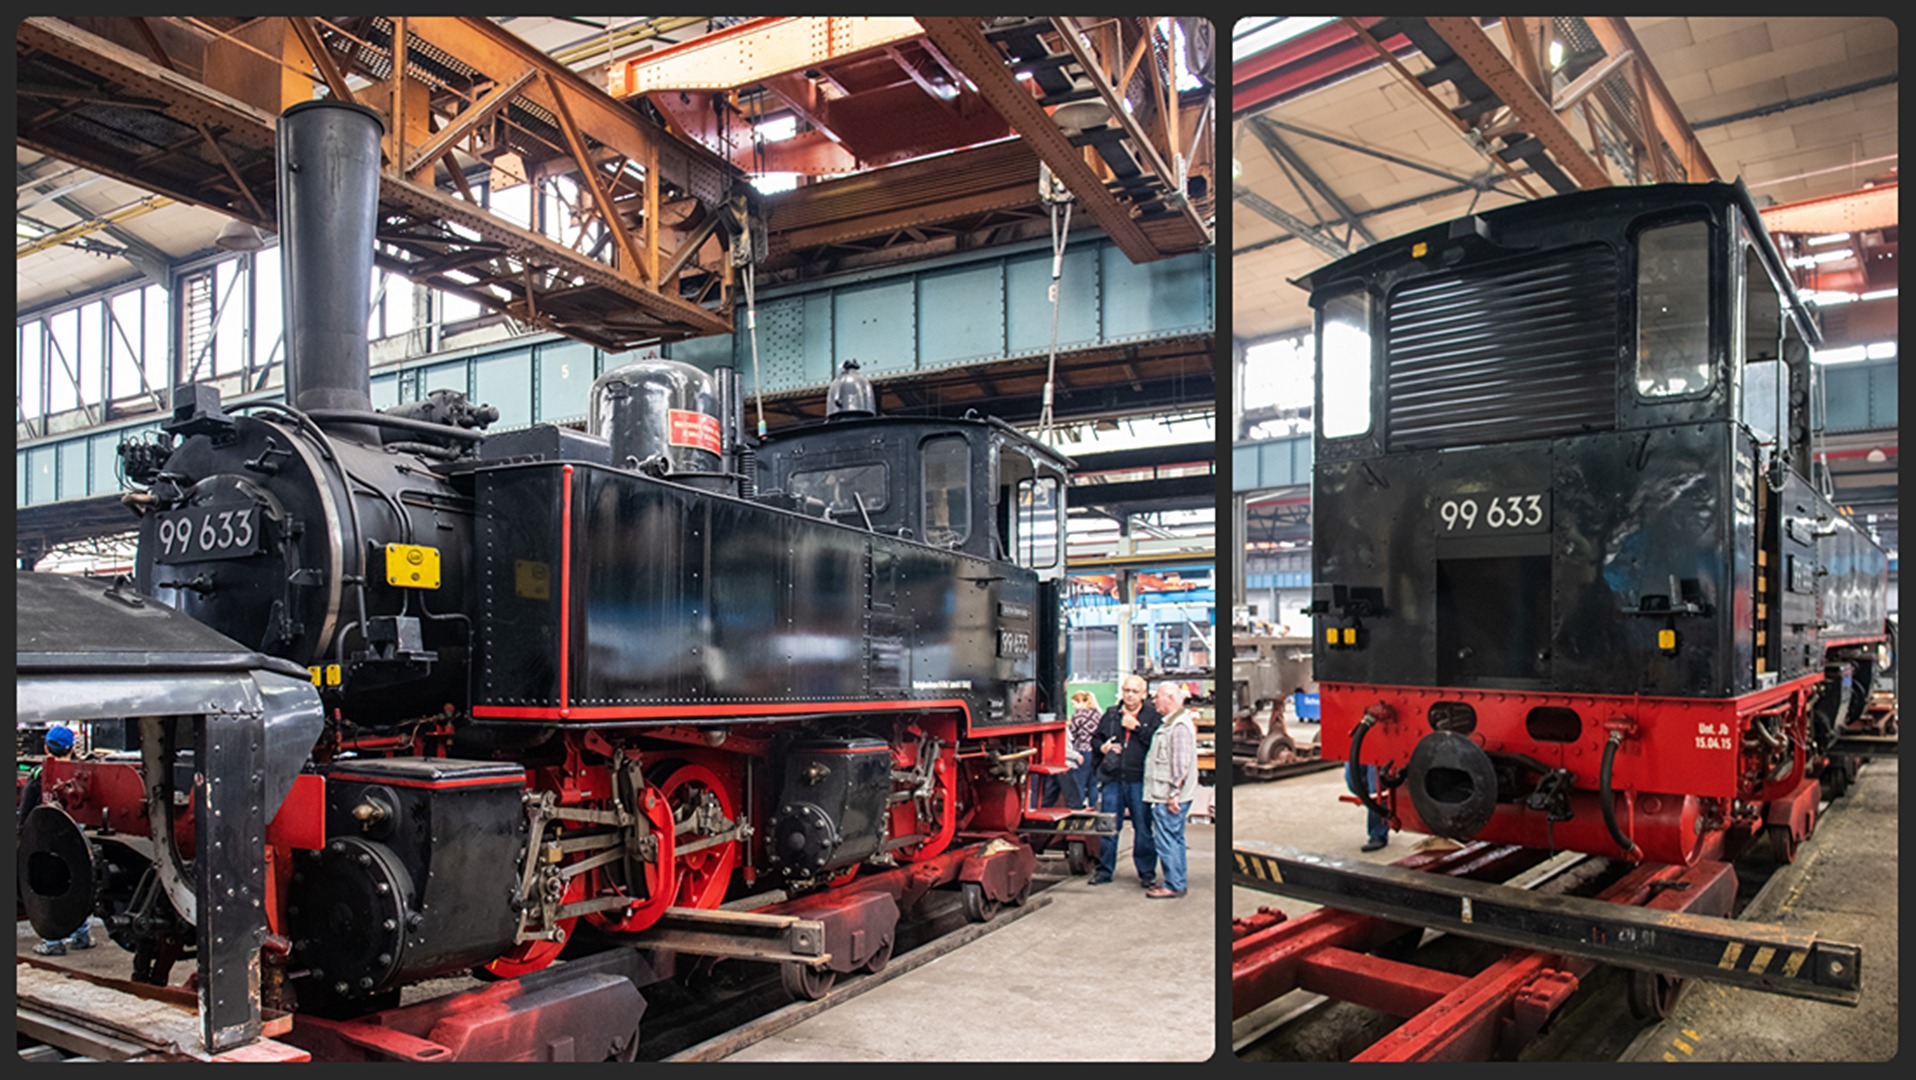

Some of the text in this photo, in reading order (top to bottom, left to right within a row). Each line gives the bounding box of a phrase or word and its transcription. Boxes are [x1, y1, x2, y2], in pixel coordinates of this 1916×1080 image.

[561, 363, 570, 379] 5
[1440, 494, 1543, 531] 99 633
[159, 508, 253, 556] 99 633
[1001, 632, 1029, 654] 99 633
[1695, 736, 1732, 750] 15.04.15
